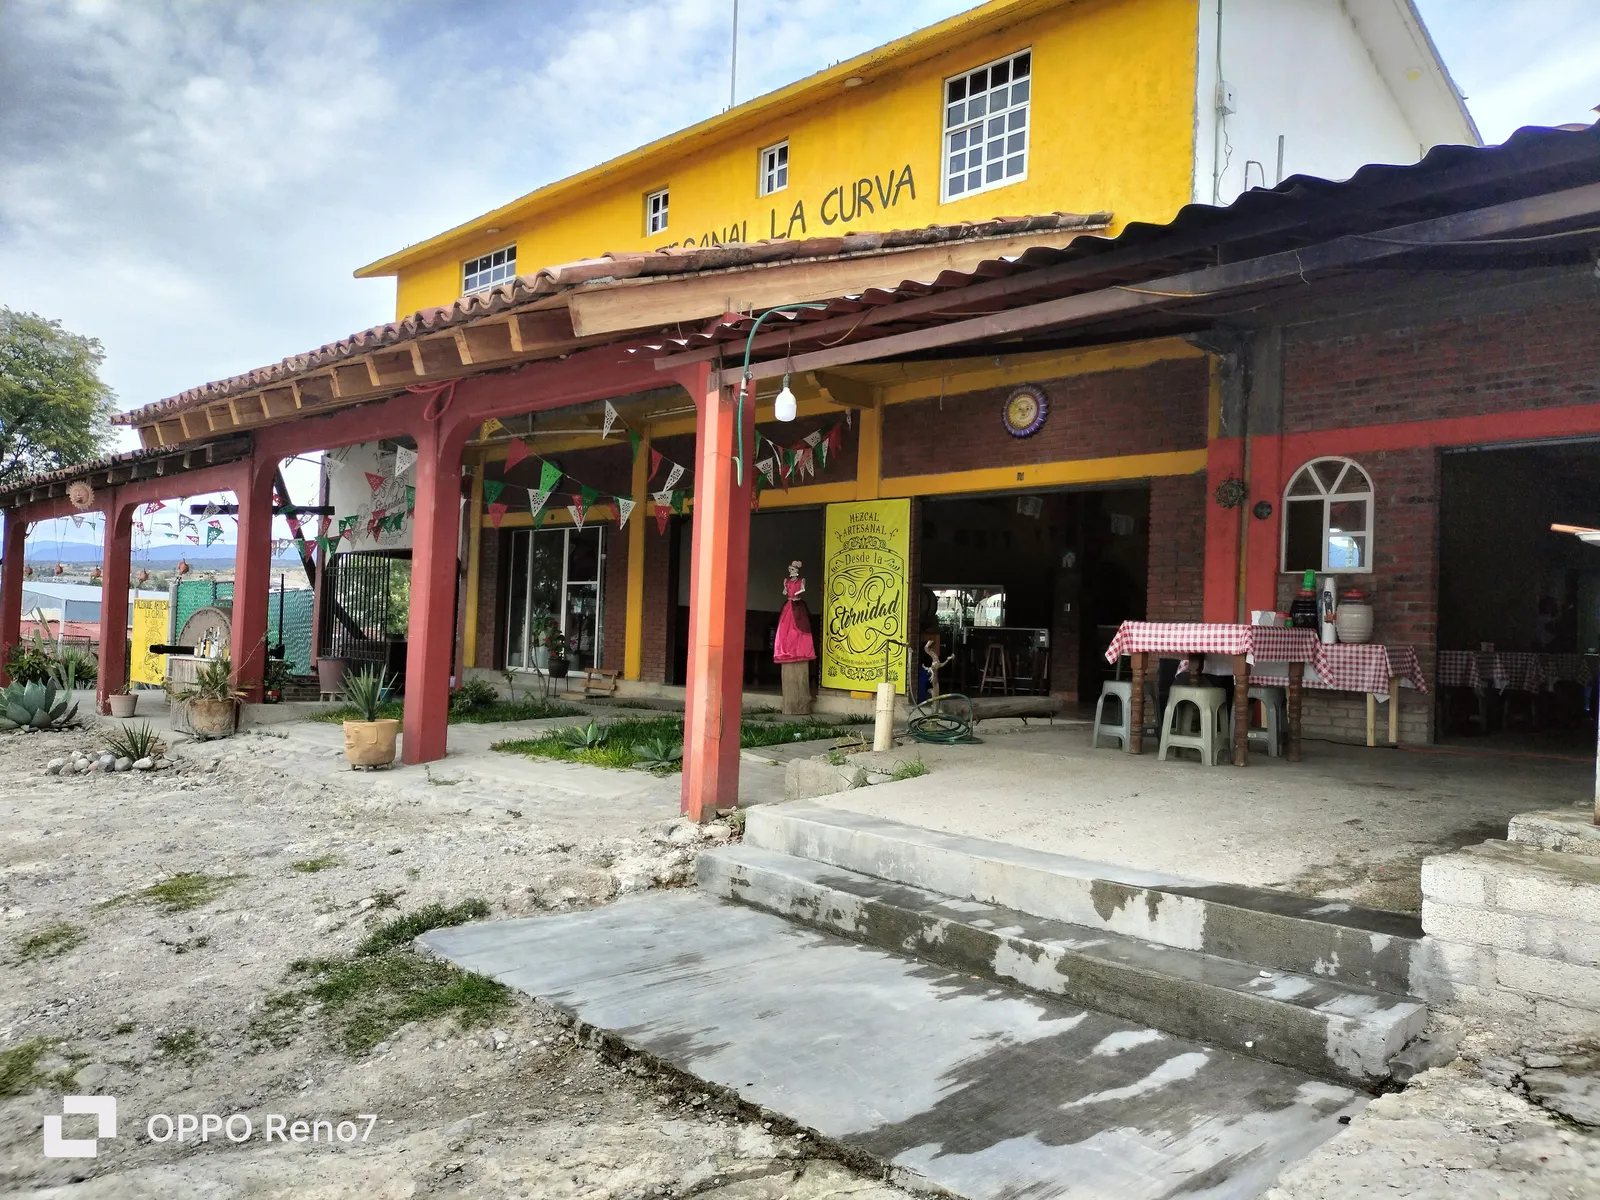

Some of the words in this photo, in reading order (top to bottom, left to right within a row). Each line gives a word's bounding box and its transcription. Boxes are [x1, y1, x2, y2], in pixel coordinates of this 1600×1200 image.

[770, 199, 807, 240] LA
[820, 164, 916, 226] CURVA
[849, 511, 880, 524] MEZCAL
[843, 523, 887, 537] ARTESANAL
[845, 552, 870, 565] Desde
[874, 552, 883, 565] la
[829, 589, 900, 637] Eternidad
